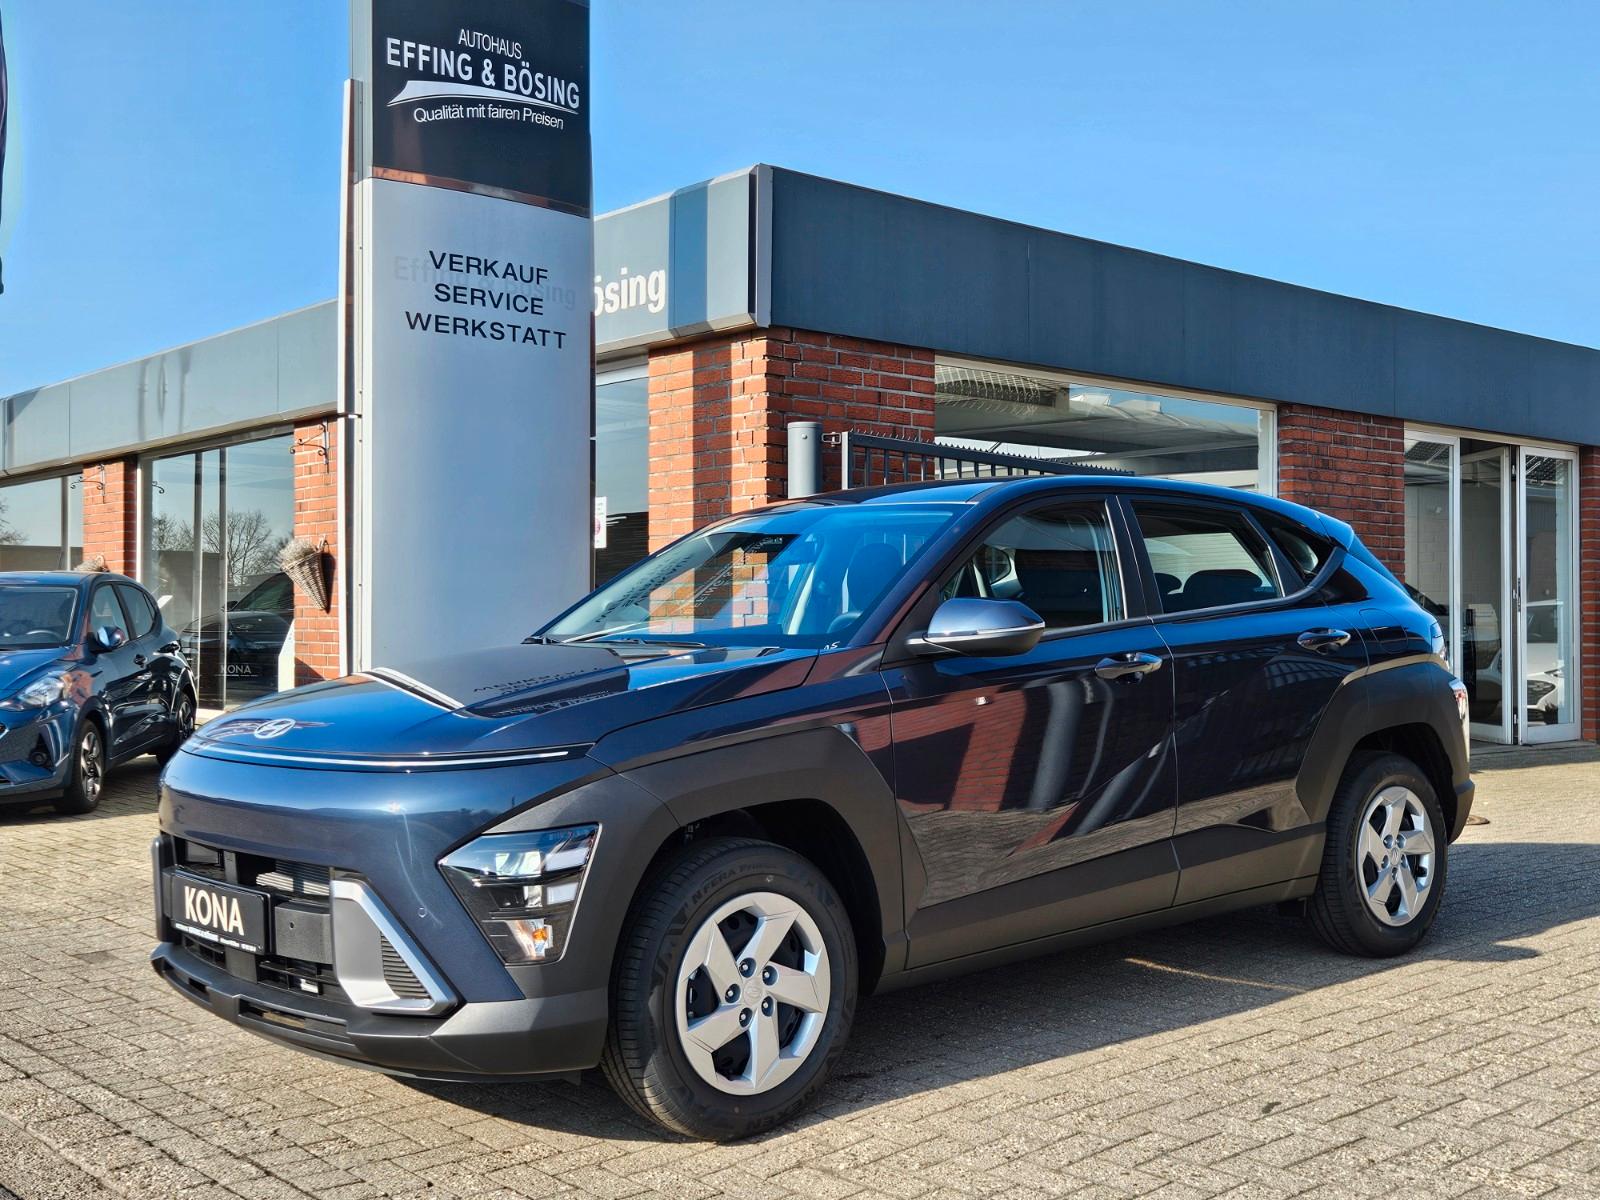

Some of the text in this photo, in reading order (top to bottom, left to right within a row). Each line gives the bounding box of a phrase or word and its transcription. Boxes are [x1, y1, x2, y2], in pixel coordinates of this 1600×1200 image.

[458, 28, 522, 60] AUTOHAUS
[386, 37, 580, 109] EFFING & BÖSING
[413, 103, 564, 130] Qualität mit fairen Preisen
[428, 249, 549, 286] VERKAUF
[434, 283, 544, 316] SERVICE
[405, 310, 567, 350] WERKSTATT
[184, 885, 245, 936] KONA
